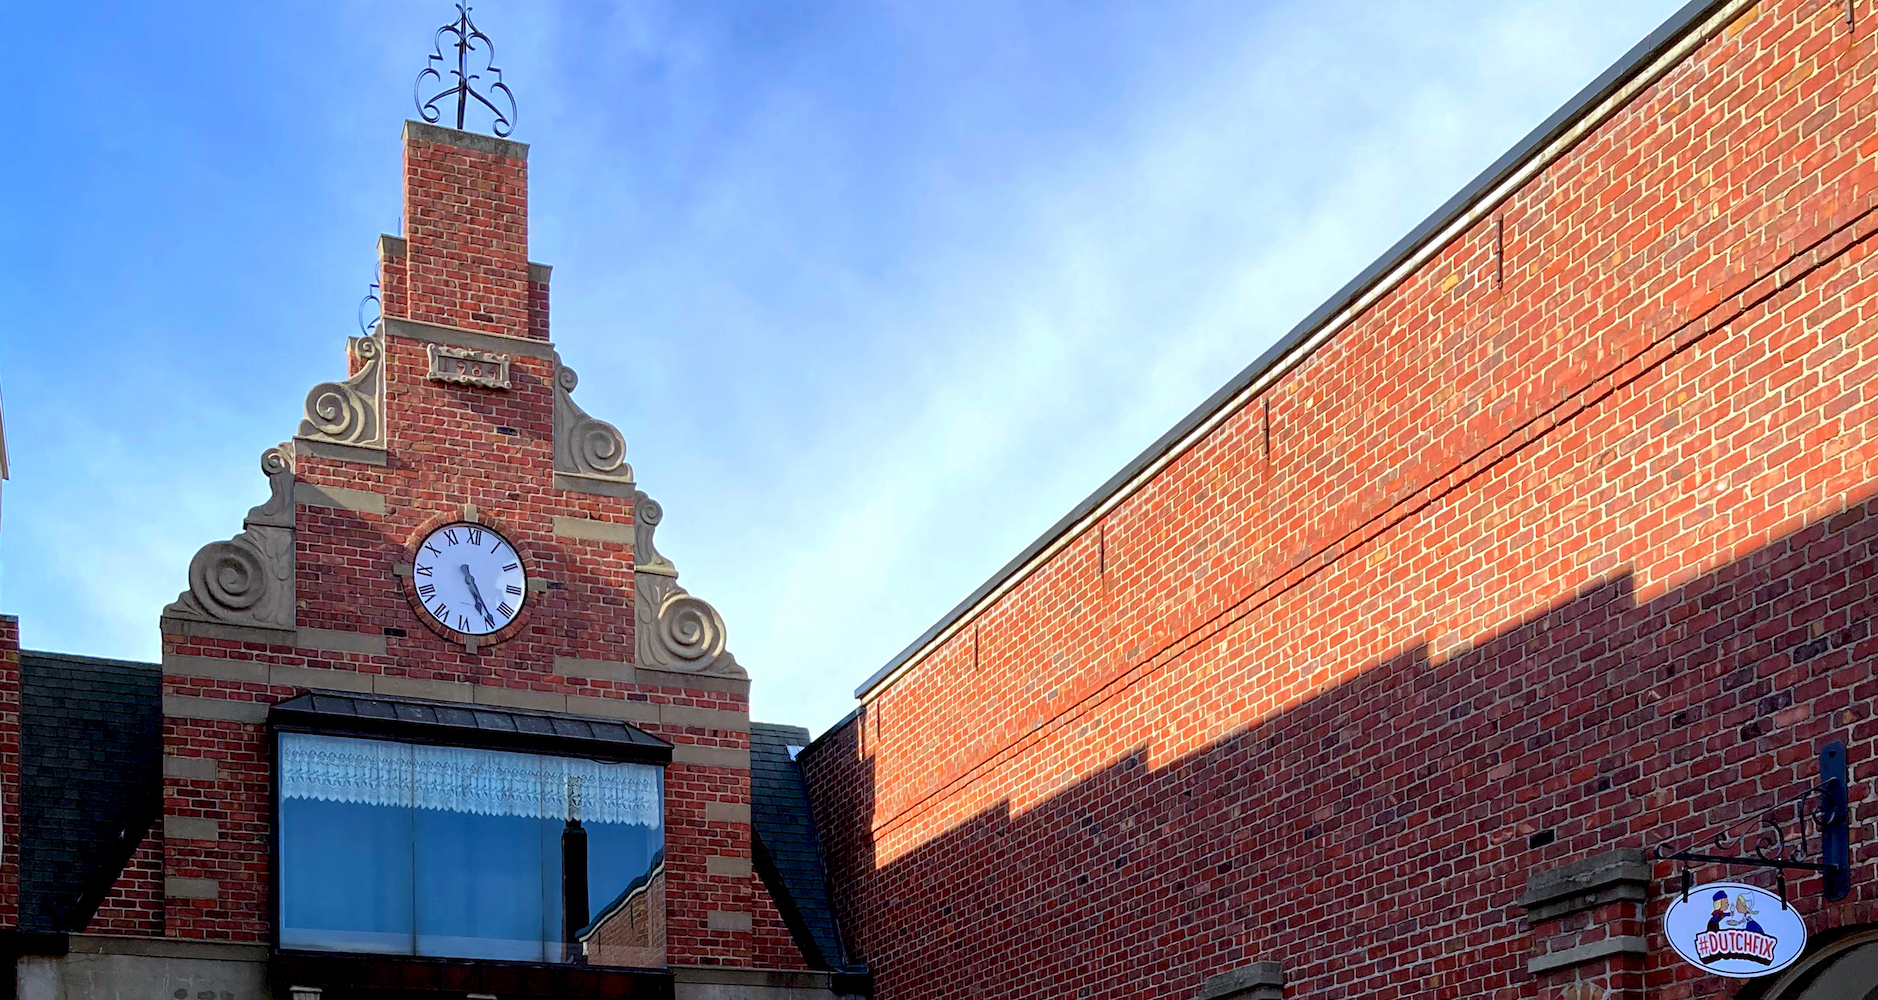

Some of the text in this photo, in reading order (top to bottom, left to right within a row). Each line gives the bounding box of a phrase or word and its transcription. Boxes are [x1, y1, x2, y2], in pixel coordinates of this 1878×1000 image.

[444, 529, 459, 547] XI
[467, 527, 482, 546] XII
[424, 541, 442, 558] X
[416, 563, 433, 577] IX
[502, 562, 518, 572] II
[418, 583, 436, 603] VIII
[505, 584, 522, 596] III
[433, 602, 450, 623] VII
[458, 614, 470, 632] VI
[1698, 932, 1775, 958] #DUTCHFIX
